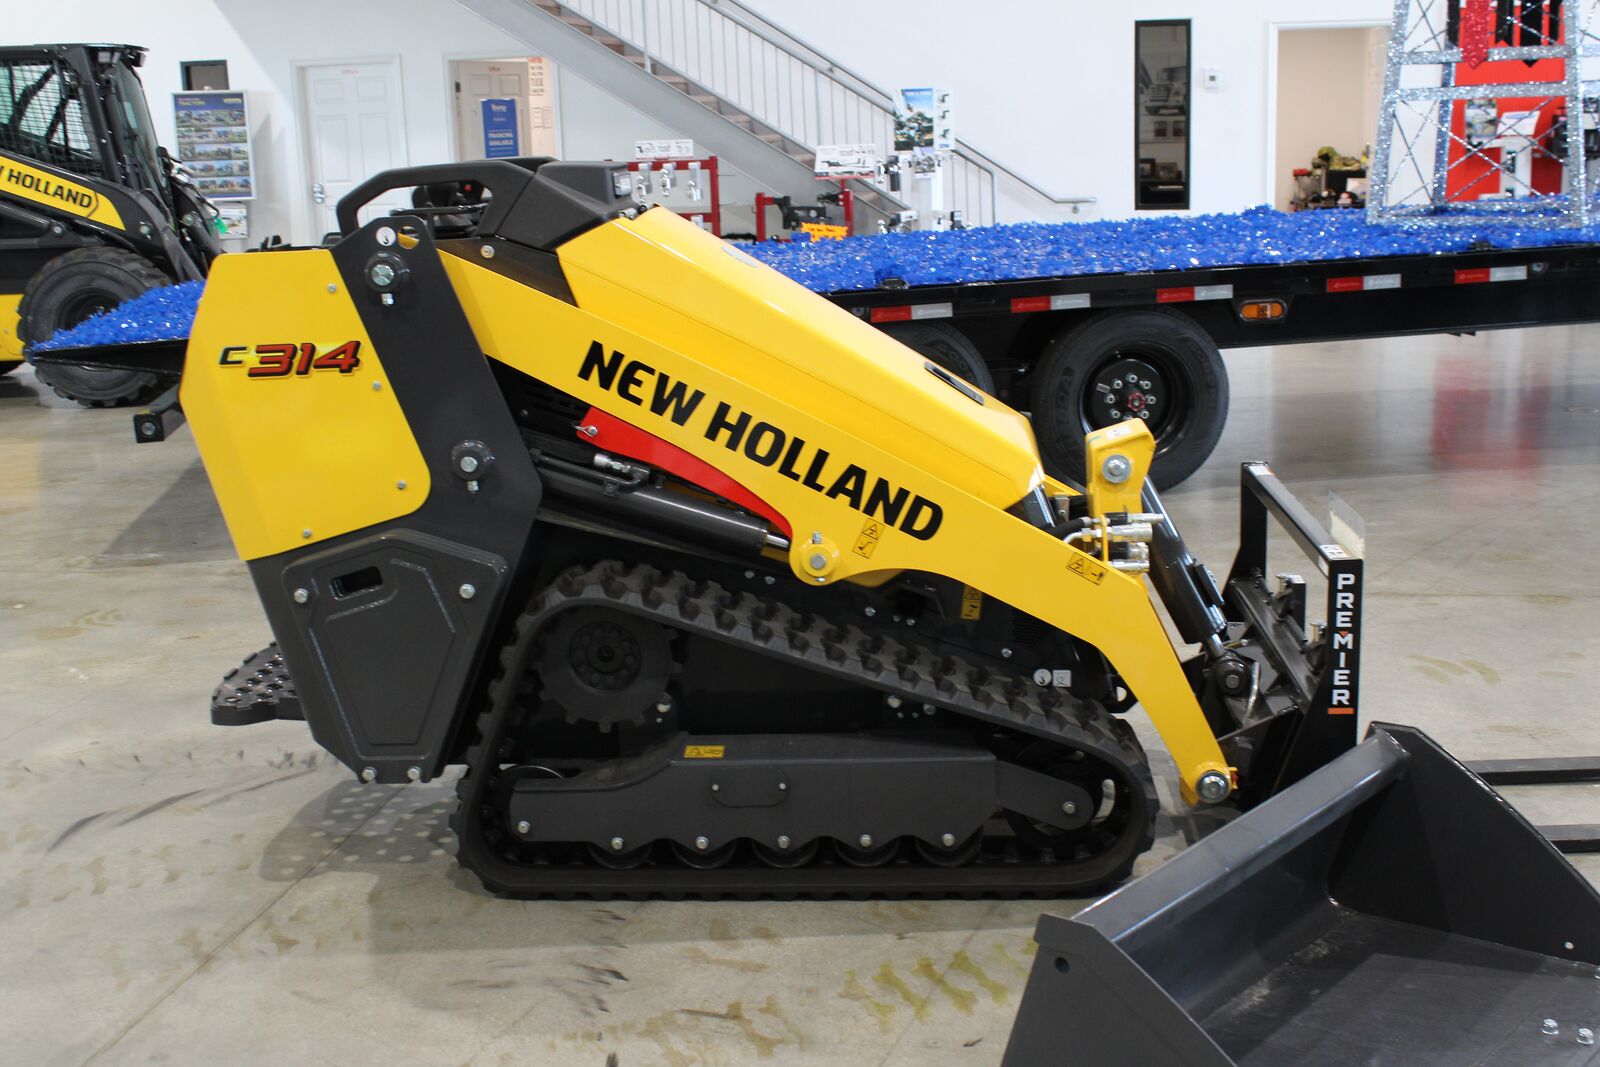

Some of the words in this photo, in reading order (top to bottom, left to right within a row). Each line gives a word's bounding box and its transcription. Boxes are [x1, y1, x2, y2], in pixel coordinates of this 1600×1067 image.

[8, 168, 92, 208] HOLLAND
[577, 340, 706, 427] NEW
[704, 401, 943, 541] HOLLAND
[1331, 573, 1356, 705] PREMIER
